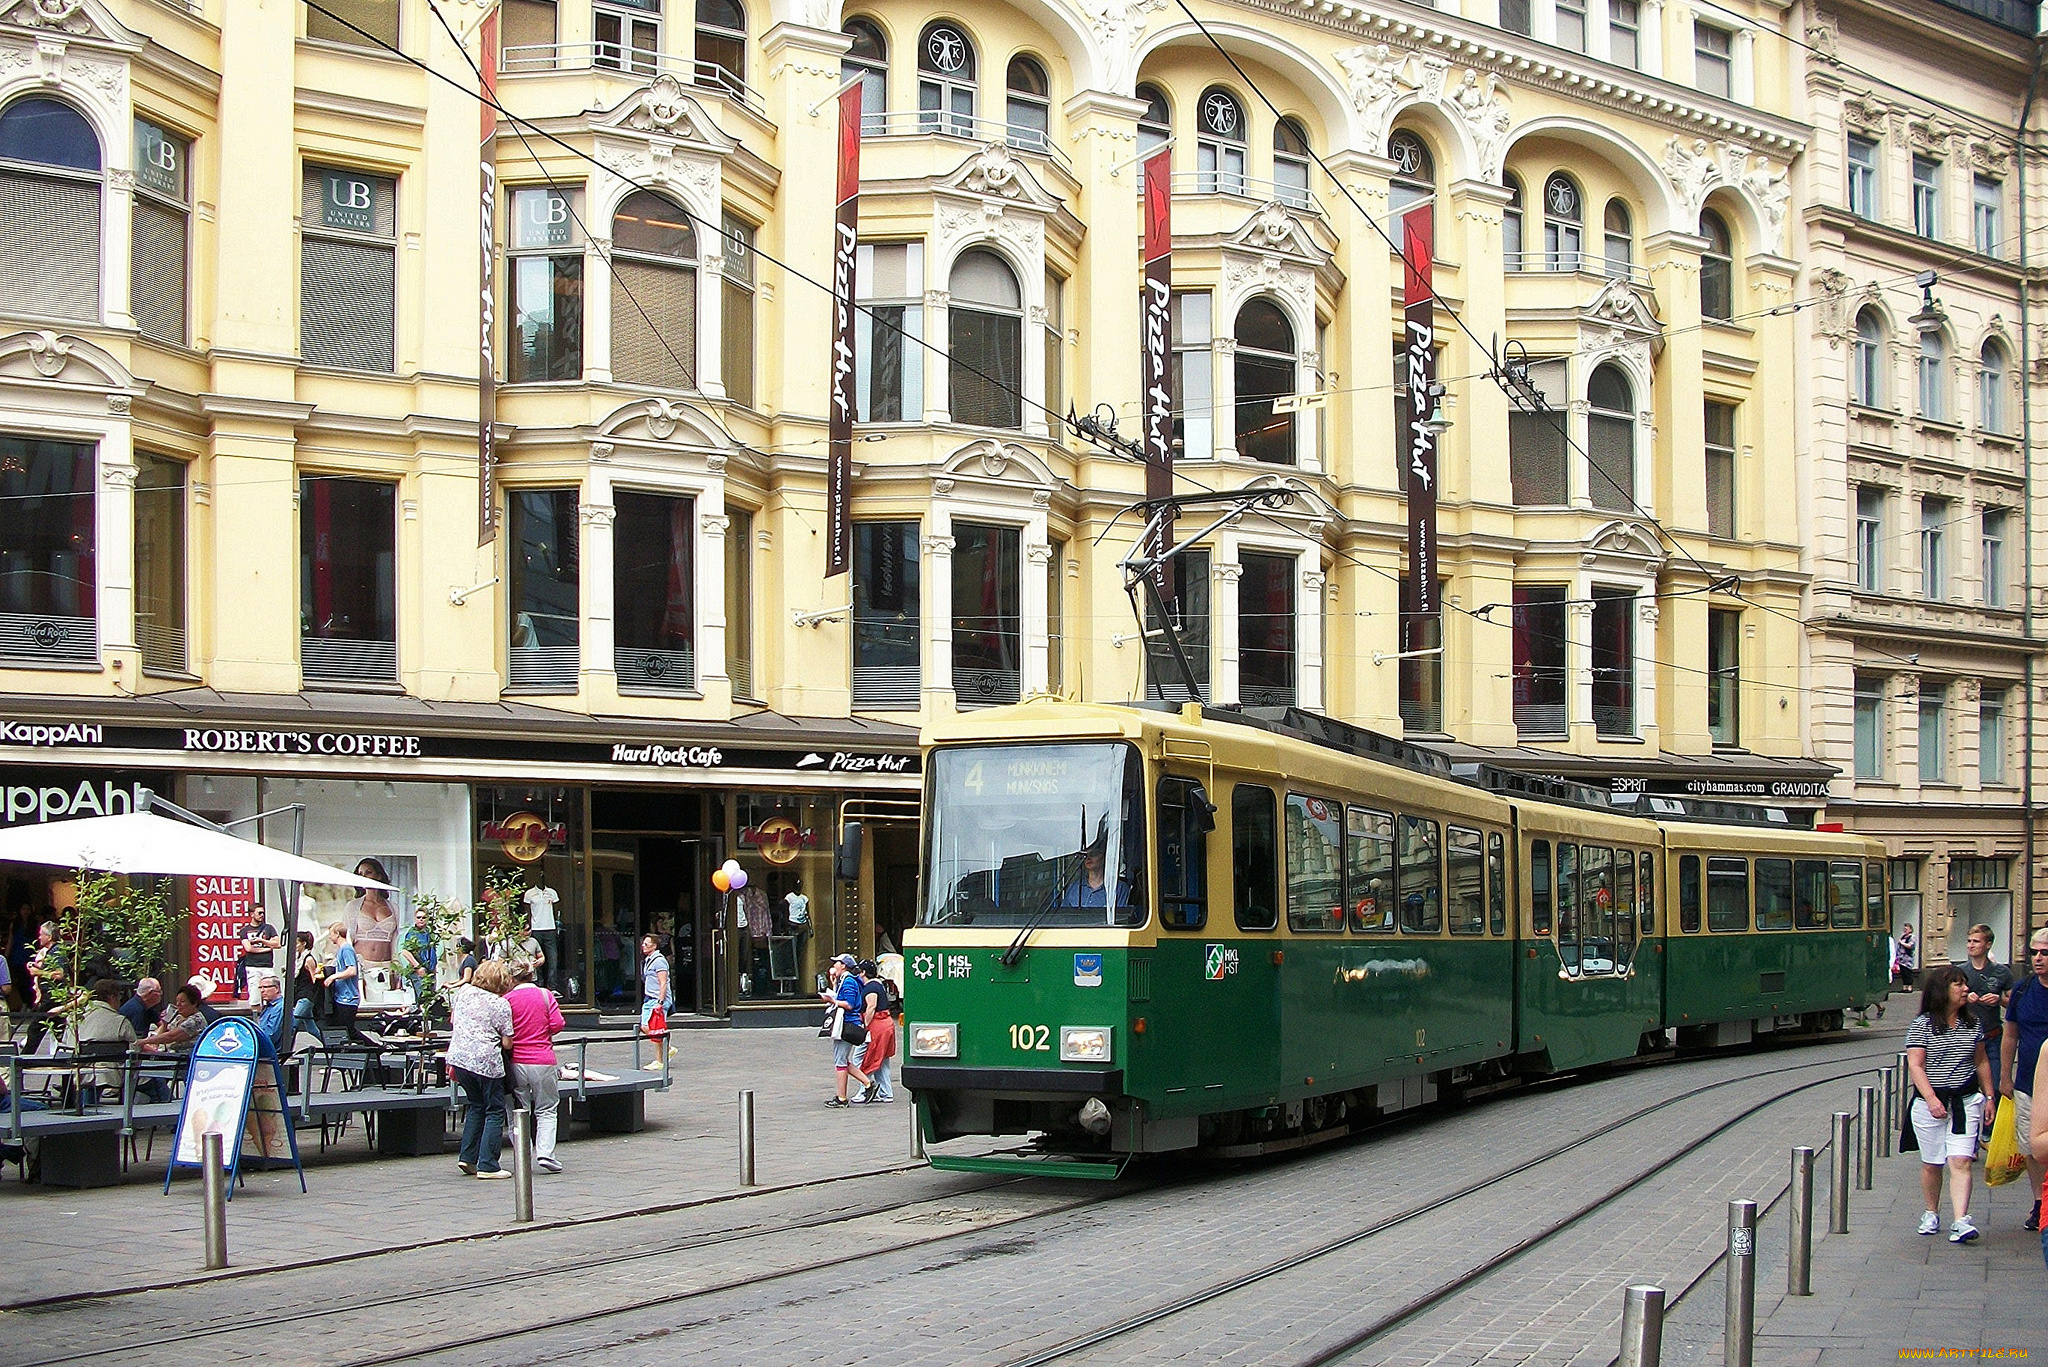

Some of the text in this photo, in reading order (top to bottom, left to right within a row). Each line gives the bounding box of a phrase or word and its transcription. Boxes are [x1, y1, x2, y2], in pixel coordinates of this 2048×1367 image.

[145, 132, 176, 172] UB
[330, 177, 371, 209] UB
[327, 216, 371, 228] BANKERS
[330, 210, 368, 221] UNITED
[480, 161, 495, 281] Pizza
[529, 198, 568, 225] UB
[526, 234, 568, 242] BANKERS
[528, 228, 565, 236] UNITED
[833, 222, 857, 423] Pizza Hut
[1146, 277, 1170, 463] Pizza Hut
[1406, 320, 1434, 492] Pizza Hut
[834, 456, 843, 566] www.pizzahut.fi
[1419, 518, 1429, 612] www.pizzahut.fi
[23, 626, 70, 638] Hard Rock
[0, 721, 103, 746] KappAhl
[183, 729, 421, 757] ROBERT'S COFFEE
[612, 744, 722, 767] Hard Rock Cafe
[828, 752, 911, 771] Pizza Hut
[964, 761, 984, 796] 4
[1612, 778, 1648, 792] ESPRIT
[1687, 780, 1765, 795] cityhammas.com
[196, 877, 249, 894] SALE!
[196, 900, 250, 917] SALE!
[948, 955, 972, 967] HSL
[1224, 949, 1239, 961] HKL
[948, 967, 972, 978] HRT
[1224, 962, 1239, 974] HST
[1009, 1024, 1050, 1050] 102
